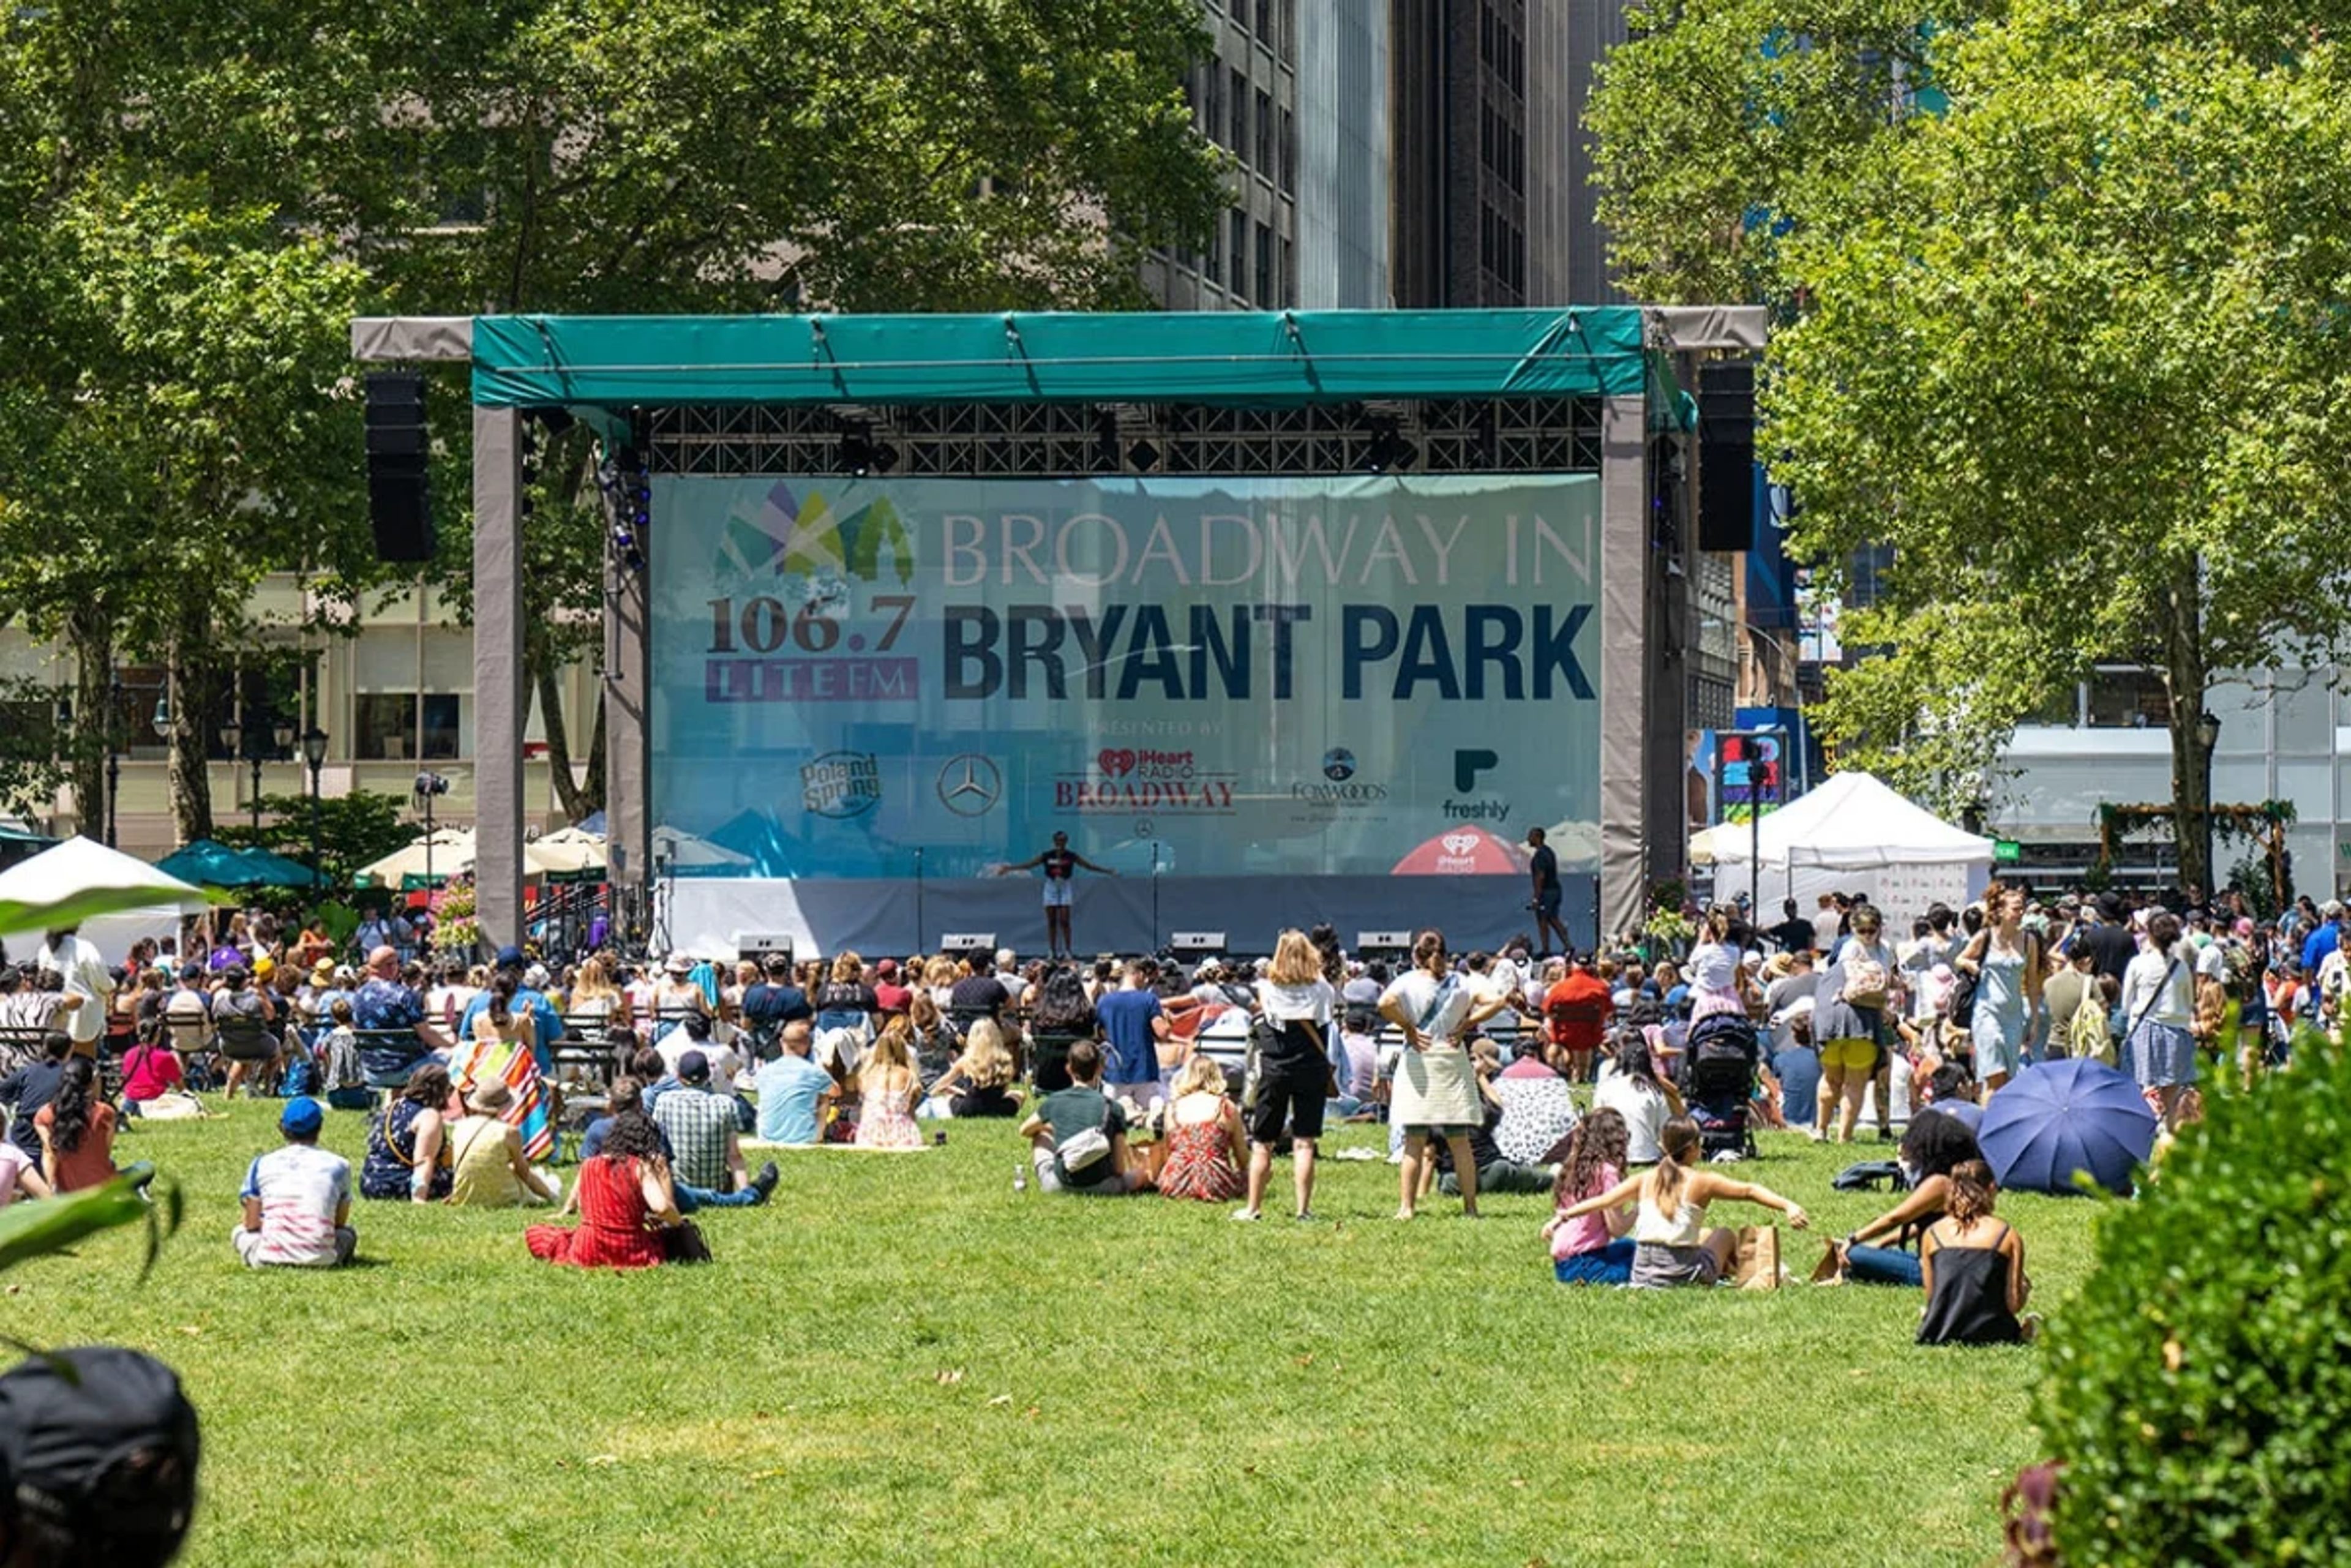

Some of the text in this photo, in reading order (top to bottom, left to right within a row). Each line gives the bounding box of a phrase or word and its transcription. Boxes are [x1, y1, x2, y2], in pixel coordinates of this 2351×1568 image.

[943, 513, 1592, 587] BROADWAY IN
[706, 595, 917, 653] 106.7
[943, 604, 1597, 700] BRYANT PARK
[800, 752, 879, 790] Poland
[1138, 749, 1193, 765] iHeart
[1138, 765, 1194, 779] RADIO
[804, 778, 880, 814] Spring
[1054, 781, 1238, 808] BROADWAY
[1442, 799, 1510, 822] freshly
